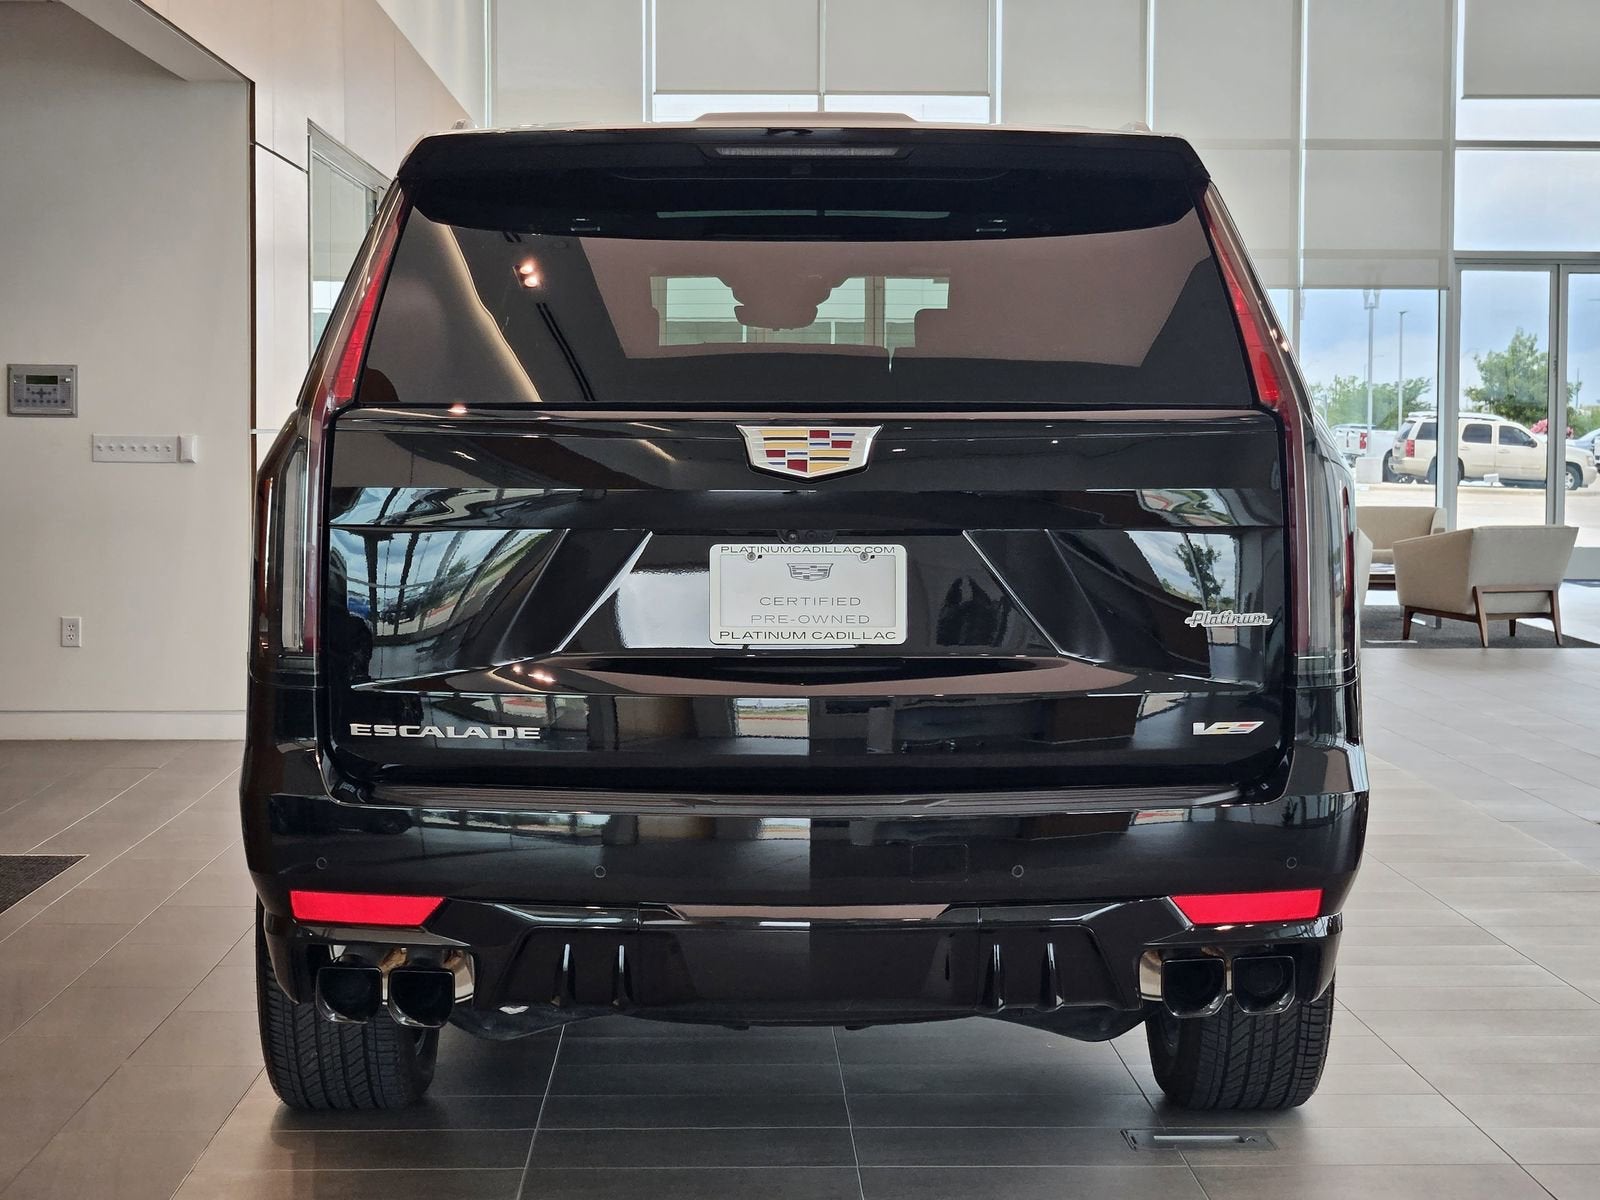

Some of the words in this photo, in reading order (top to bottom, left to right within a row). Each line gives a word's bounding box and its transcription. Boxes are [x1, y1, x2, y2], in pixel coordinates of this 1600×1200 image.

[759, 597, 861, 606] CERTIFIED
[751, 615, 870, 624] PRE-OWNED
[1185, 610, 1273, 627] Platinum
[720, 631, 806, 640] PLATINUM
[811, 631, 896, 640] CADILLAC
[350, 723, 541, 739] ESCALADE
